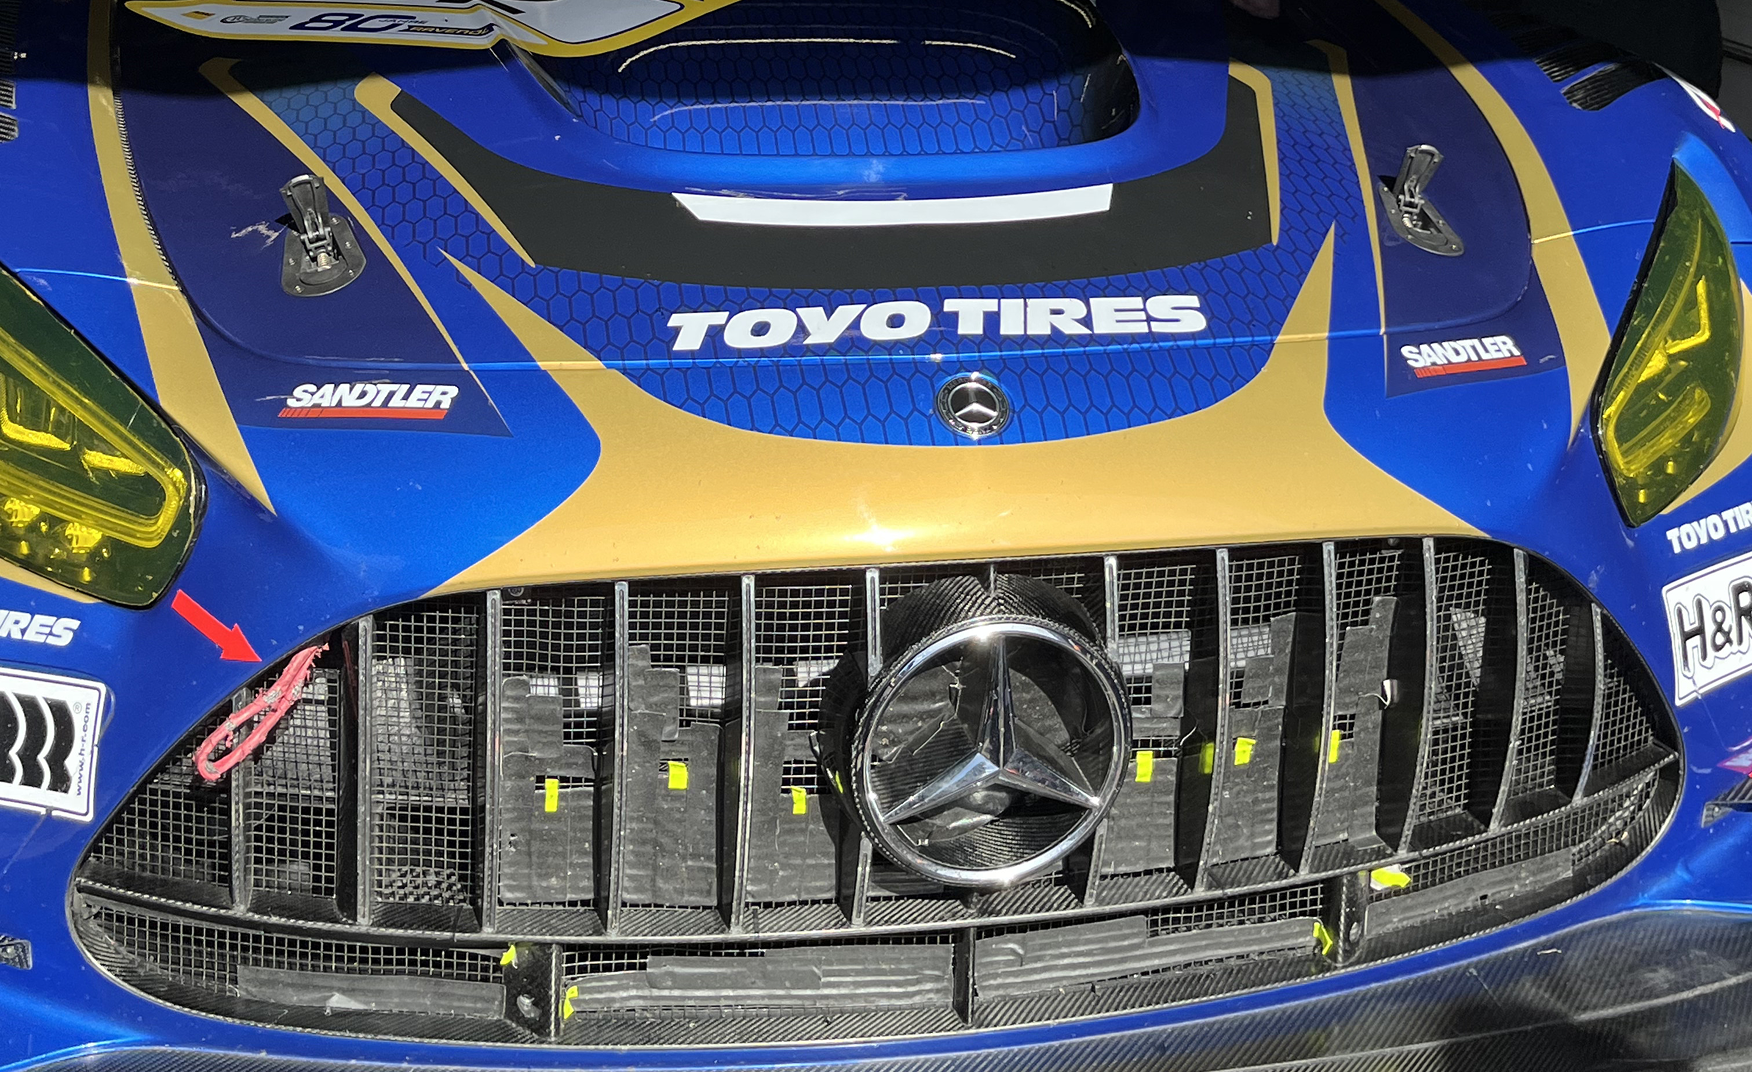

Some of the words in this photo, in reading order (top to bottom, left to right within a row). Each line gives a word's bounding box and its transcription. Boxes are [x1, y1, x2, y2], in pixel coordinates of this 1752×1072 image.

[666, 300, 932, 351] TOYO
[943, 294, 1208, 336] TIRES
[1400, 334, 1521, 368] SANDTLER
[286, 383, 459, 409] SANDTLER
[1665, 513, 1726, 555] TOYO
[1676, 580, 1752, 672] H&R
[75, 702, 92, 797] www.h-r.com
